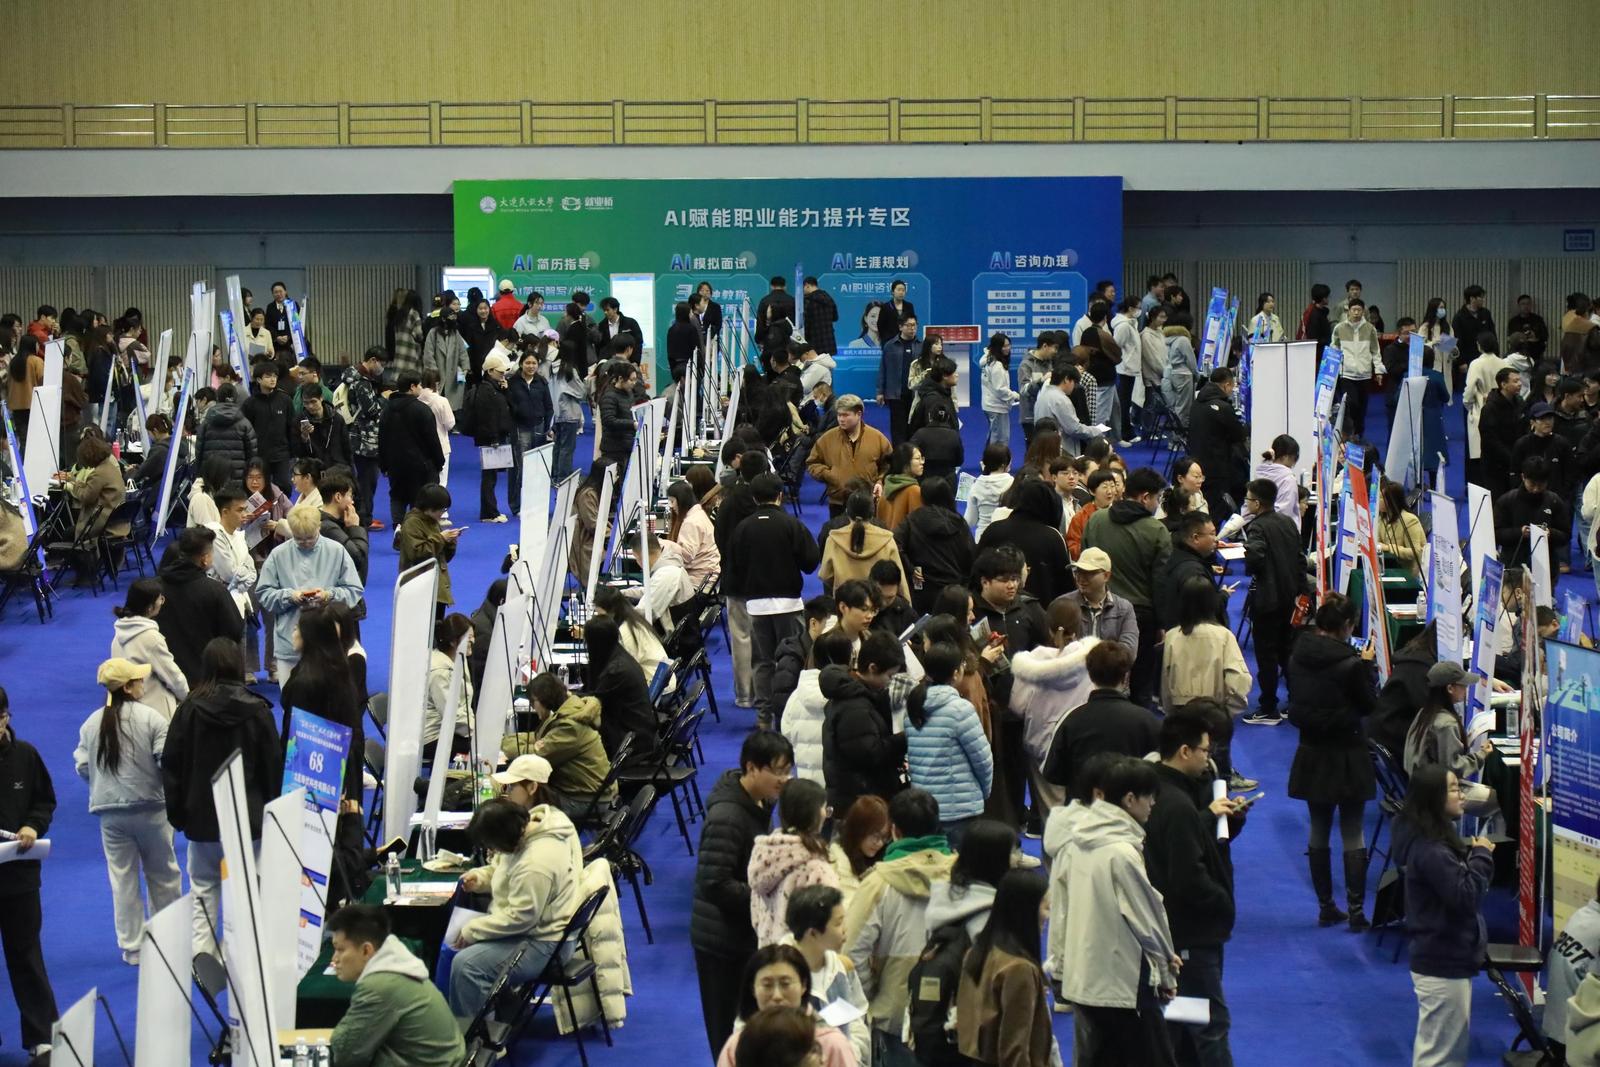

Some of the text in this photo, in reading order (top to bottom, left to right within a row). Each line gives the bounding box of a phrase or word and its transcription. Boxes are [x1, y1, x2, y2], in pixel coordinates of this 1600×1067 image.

[664, 207, 911, 229] AI赋能职业能力提升专区
[513, 254, 591, 272] AI 简历指导
[671, 253, 748, 271] AI 模拟面试
[831, 252, 909, 271] AI 生涯规划
[989, 251, 1069, 270] AI 咨询办理
[309, 751, 324, 774] 68
